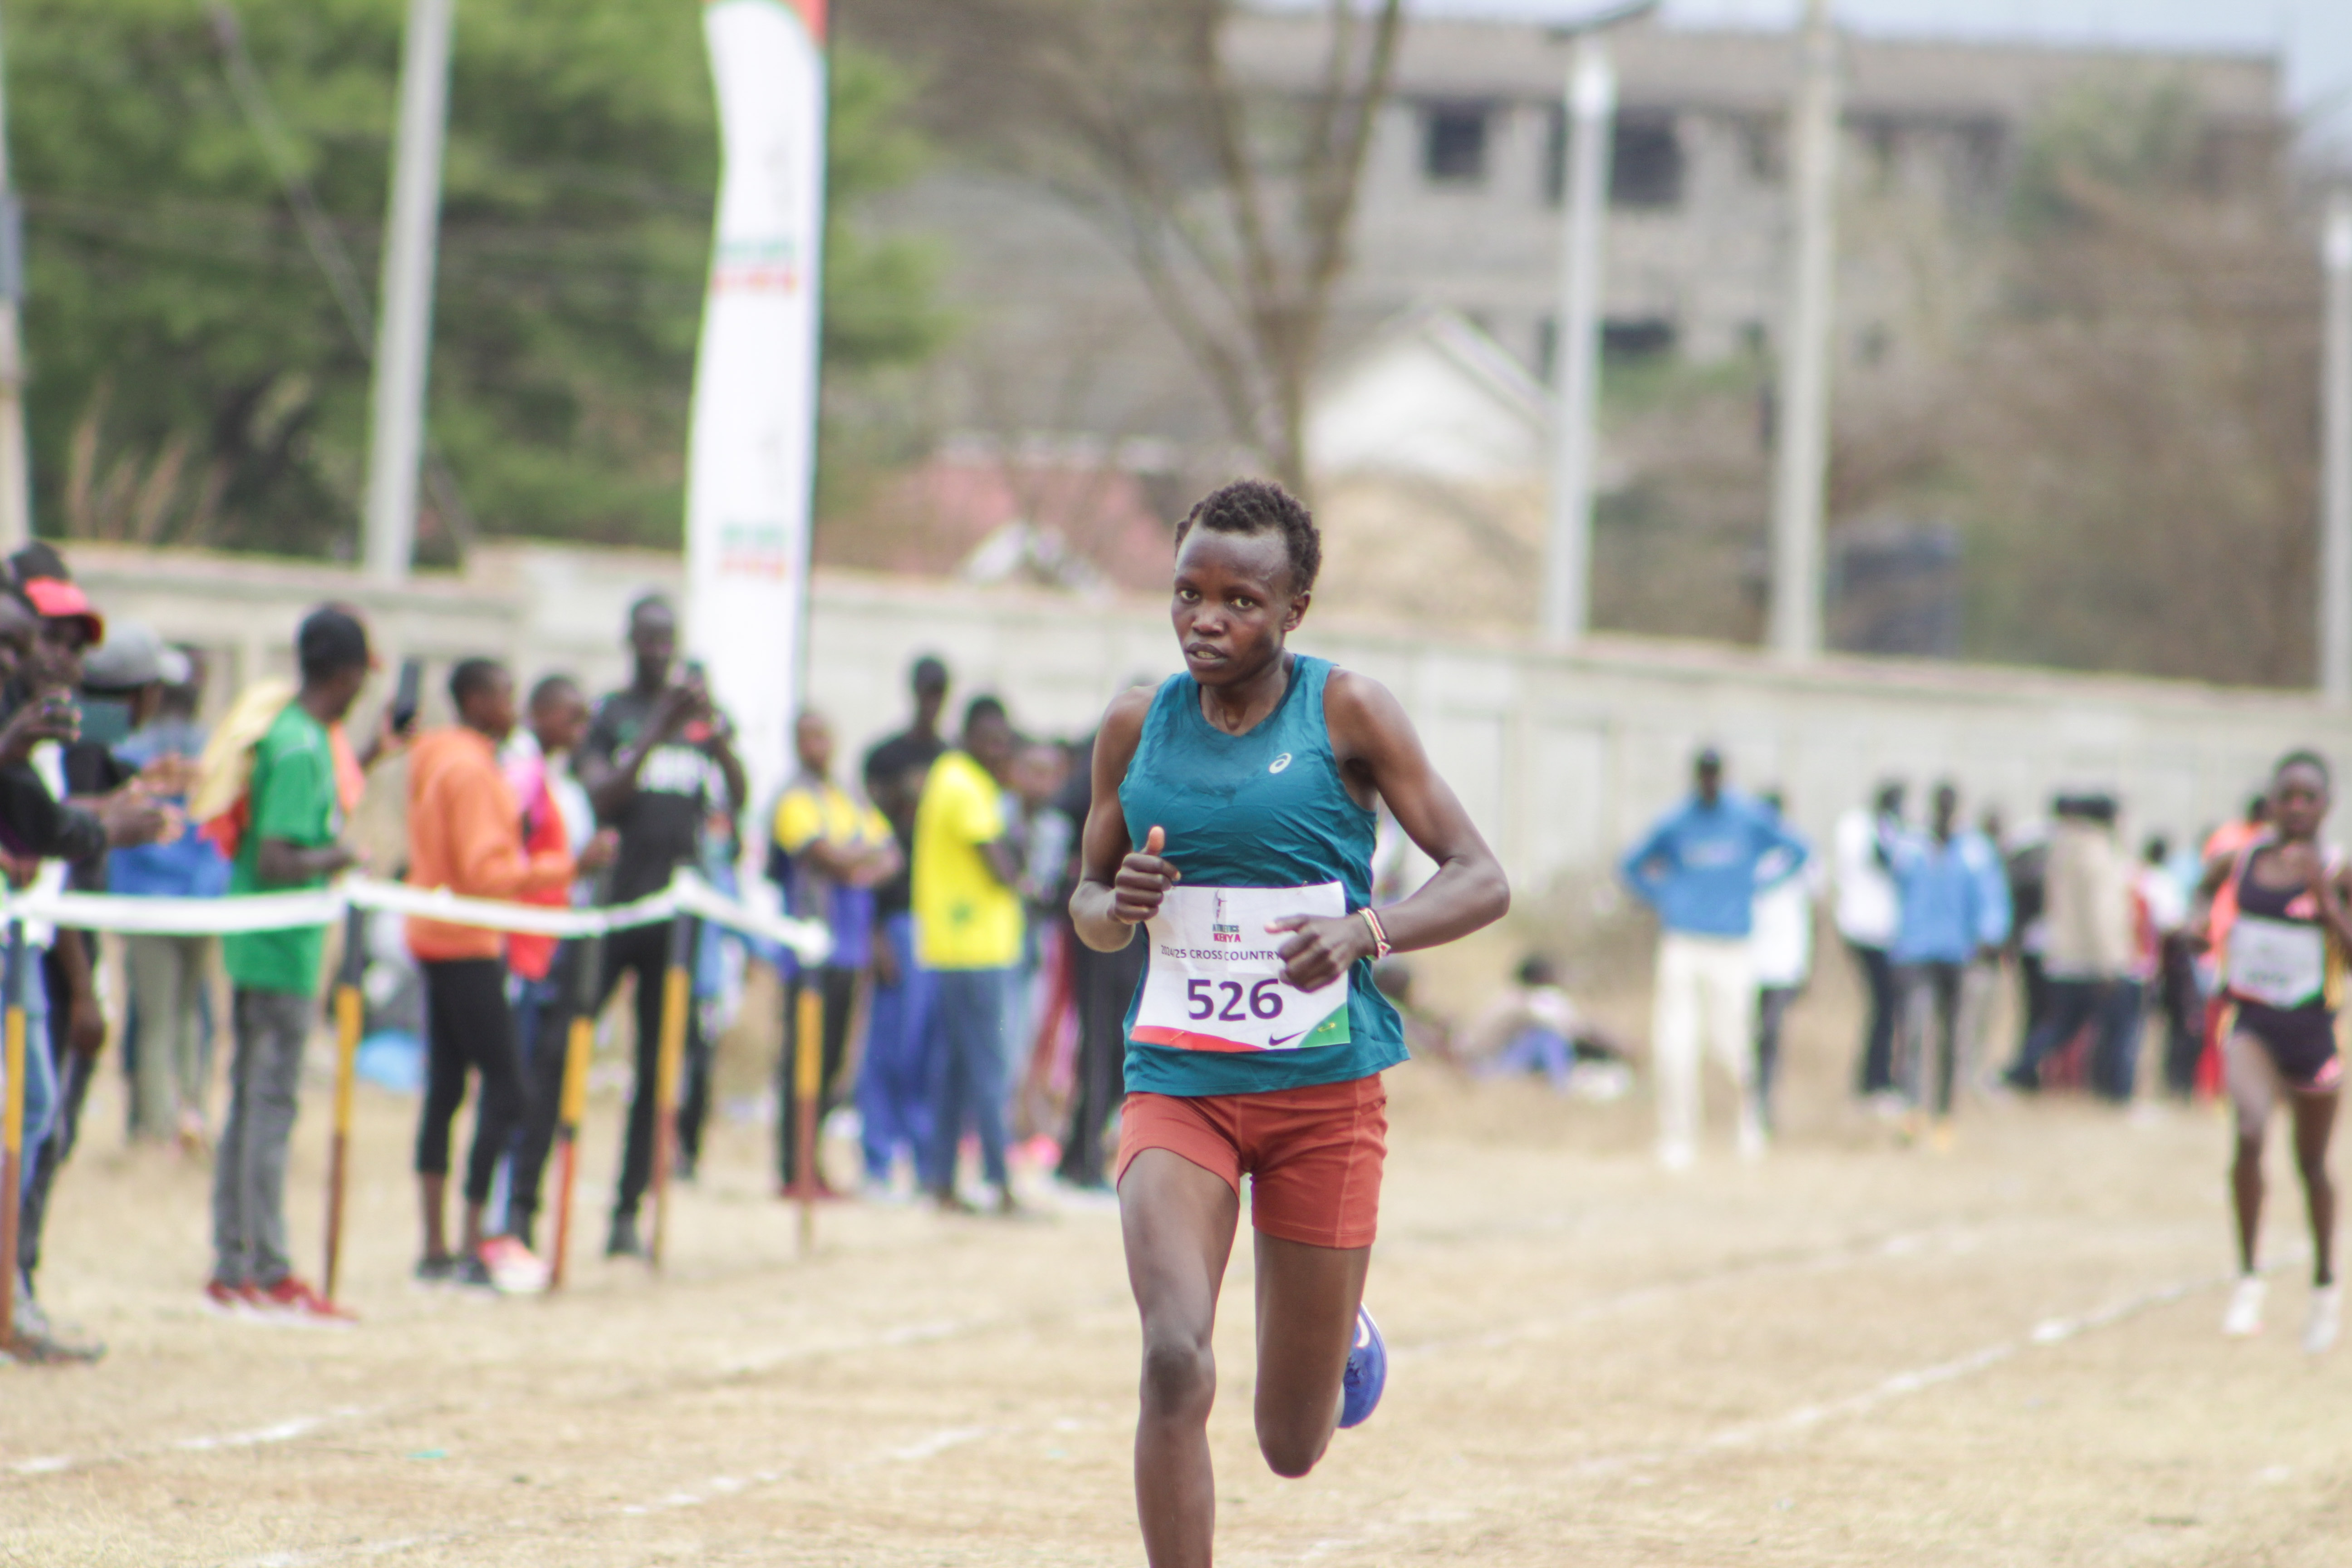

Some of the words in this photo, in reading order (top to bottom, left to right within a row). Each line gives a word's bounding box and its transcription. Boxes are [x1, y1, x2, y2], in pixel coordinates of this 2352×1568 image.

[1213, 933, 1241, 943] KENYA
[1161, 944, 1187, 958] 2024/25
[1190, 949, 1223, 960] CROSS
[1188, 978, 1283, 1022] 526
